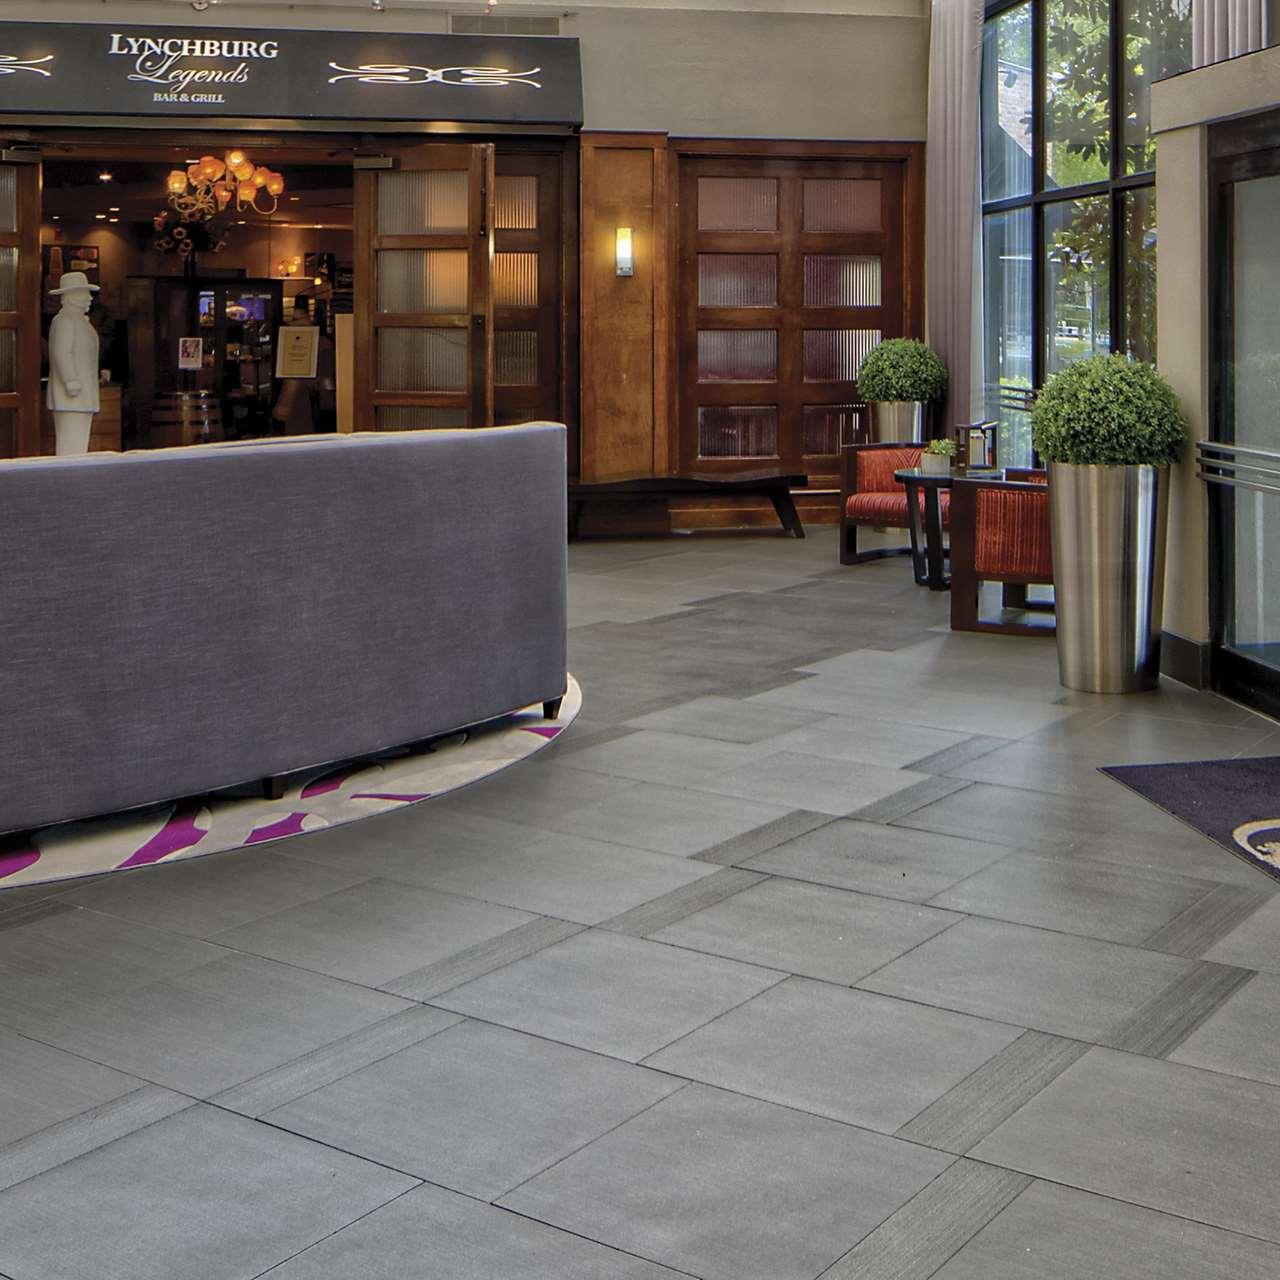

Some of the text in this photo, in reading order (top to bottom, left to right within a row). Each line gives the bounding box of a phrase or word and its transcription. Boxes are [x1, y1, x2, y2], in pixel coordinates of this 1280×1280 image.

[109, 33, 279, 58] LYNCHBURG
[127, 51, 251, 93] Legends
[153, 93, 225, 103] BAR & GRILL
